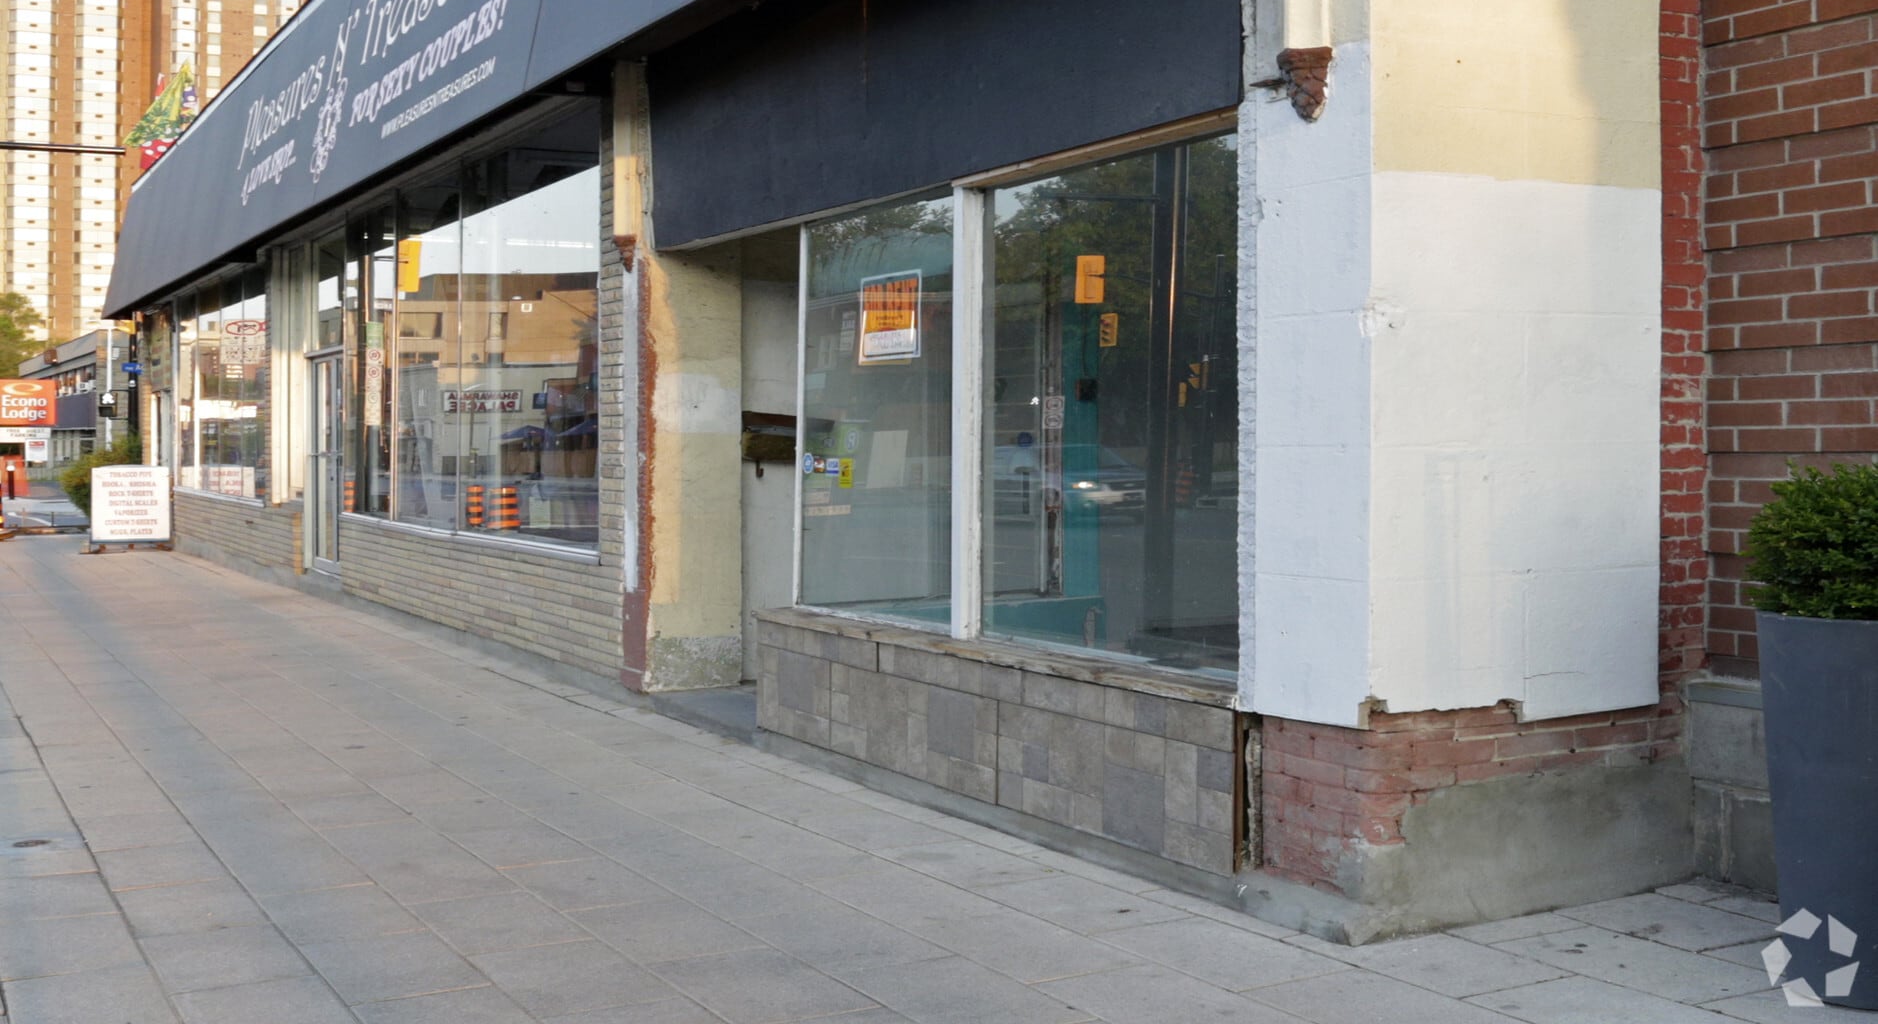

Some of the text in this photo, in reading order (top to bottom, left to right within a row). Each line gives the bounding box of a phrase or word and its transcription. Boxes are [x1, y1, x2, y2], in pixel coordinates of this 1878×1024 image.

[349, 81, 379, 128] FOR
[377, 51, 421, 108] SEXY
[238, 55, 326, 170] Pleasures
[1, 395, 47, 407] Econo
[1, 407, 47, 421] Lodge
